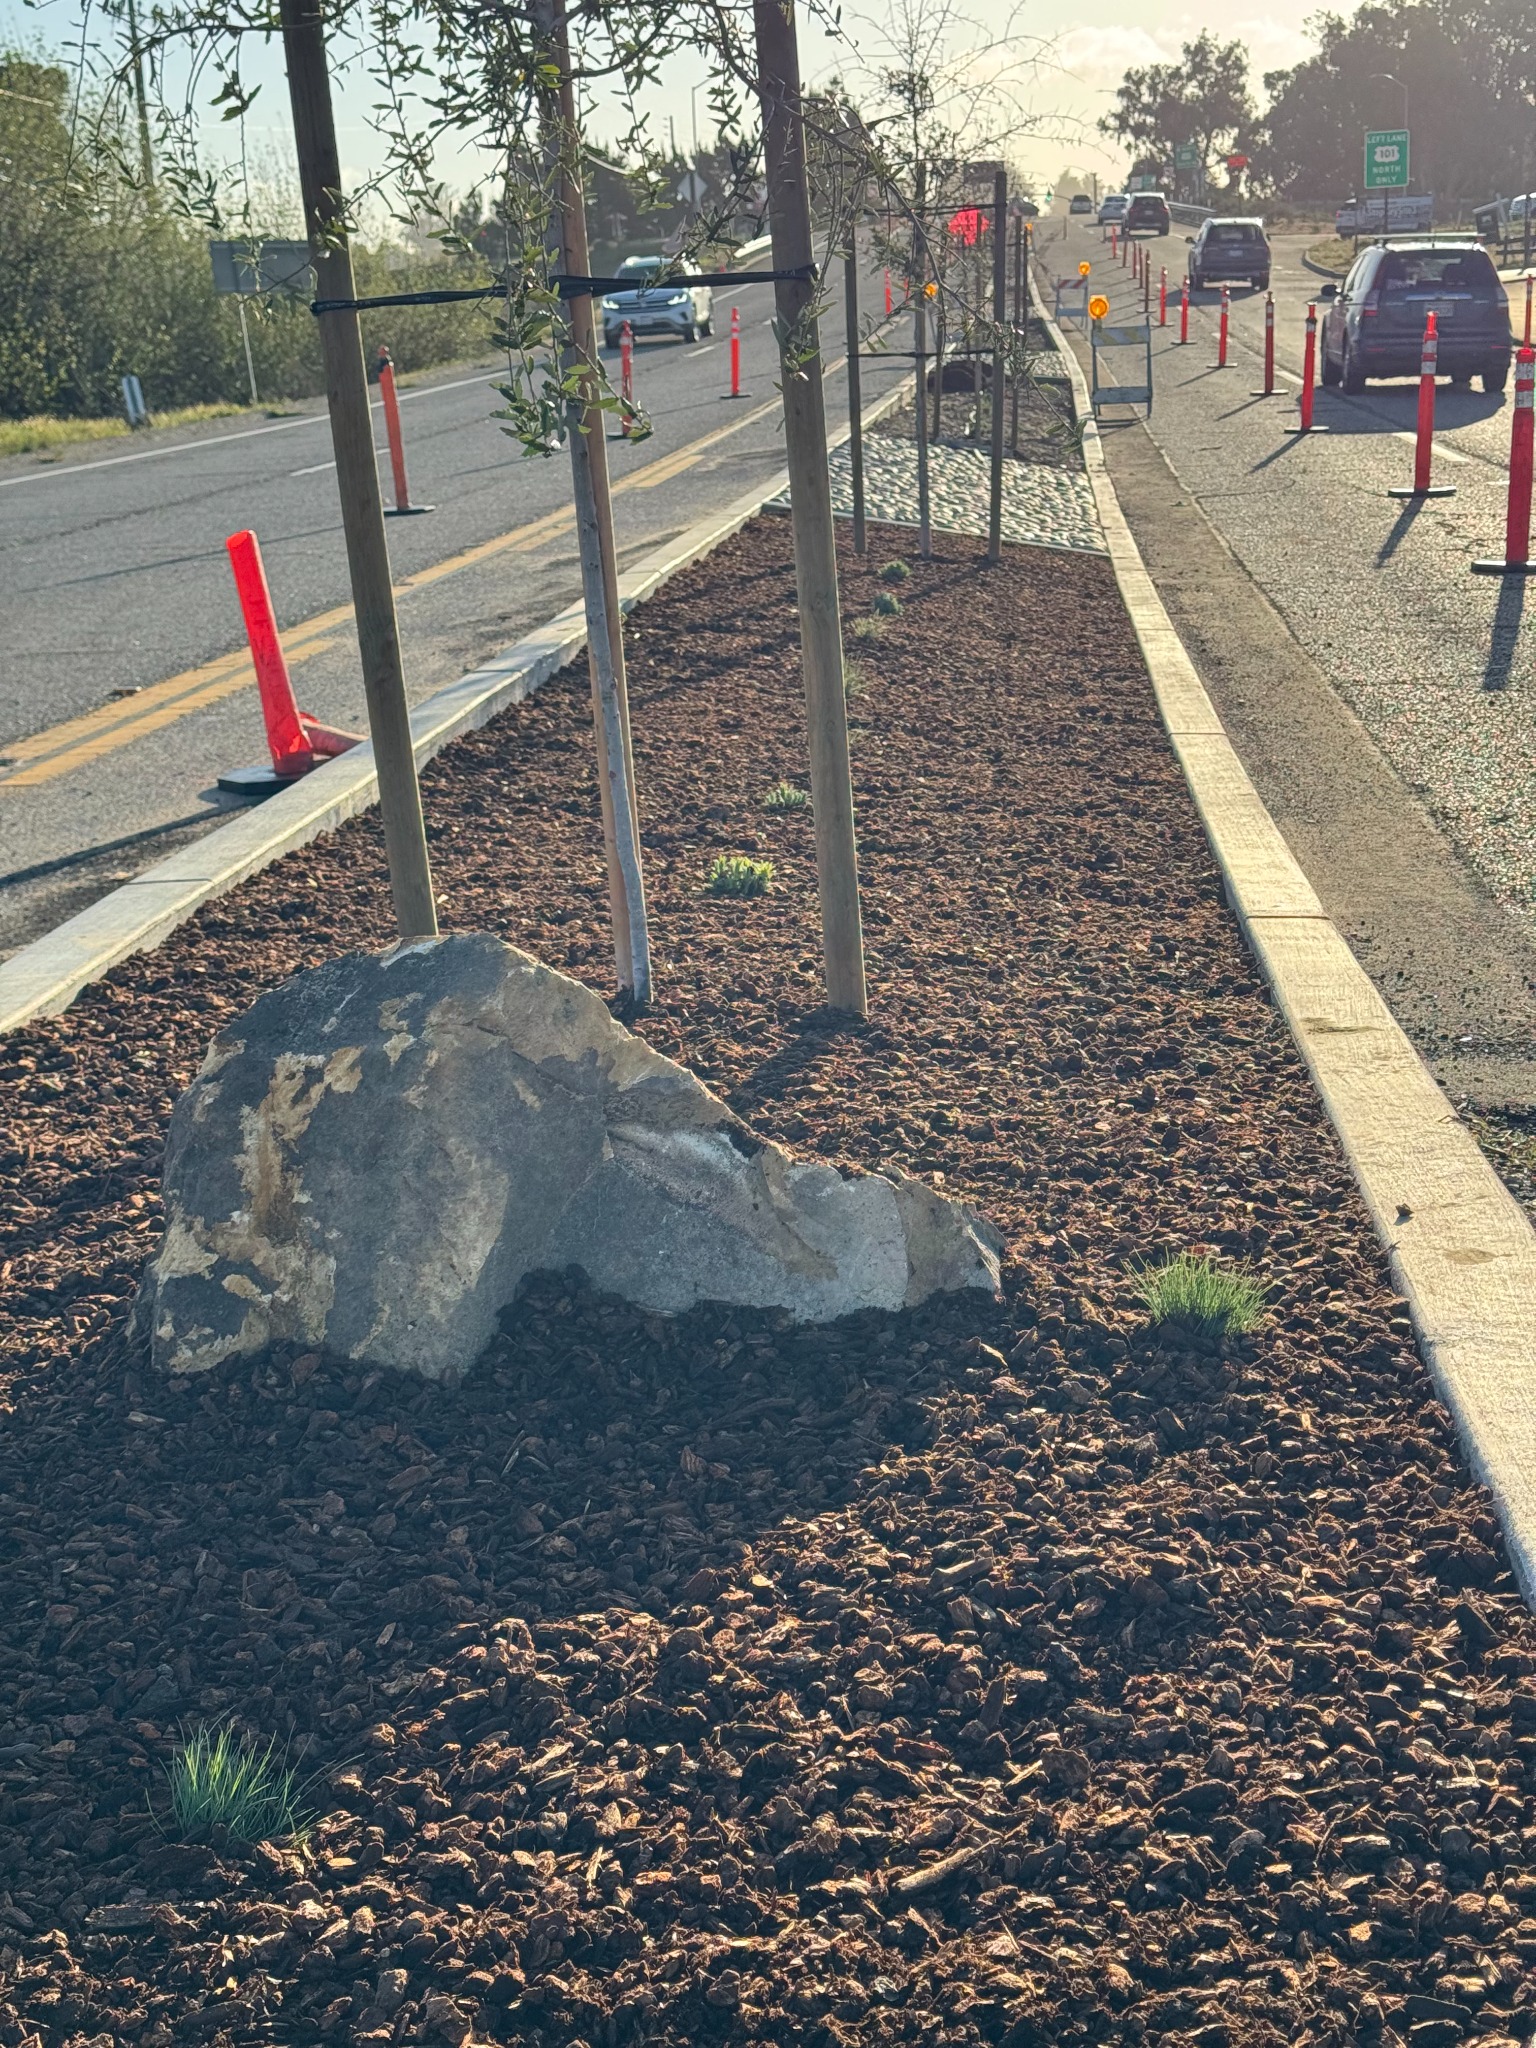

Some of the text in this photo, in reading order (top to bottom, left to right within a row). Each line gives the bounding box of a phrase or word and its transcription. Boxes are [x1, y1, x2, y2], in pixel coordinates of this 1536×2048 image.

[1367, 134, 1406, 143] LEFT LANE
[1380, 149, 1395, 158] 101
[1373, 165, 1401, 174] NORTH
[1376, 176, 1397, 184] ONLY
